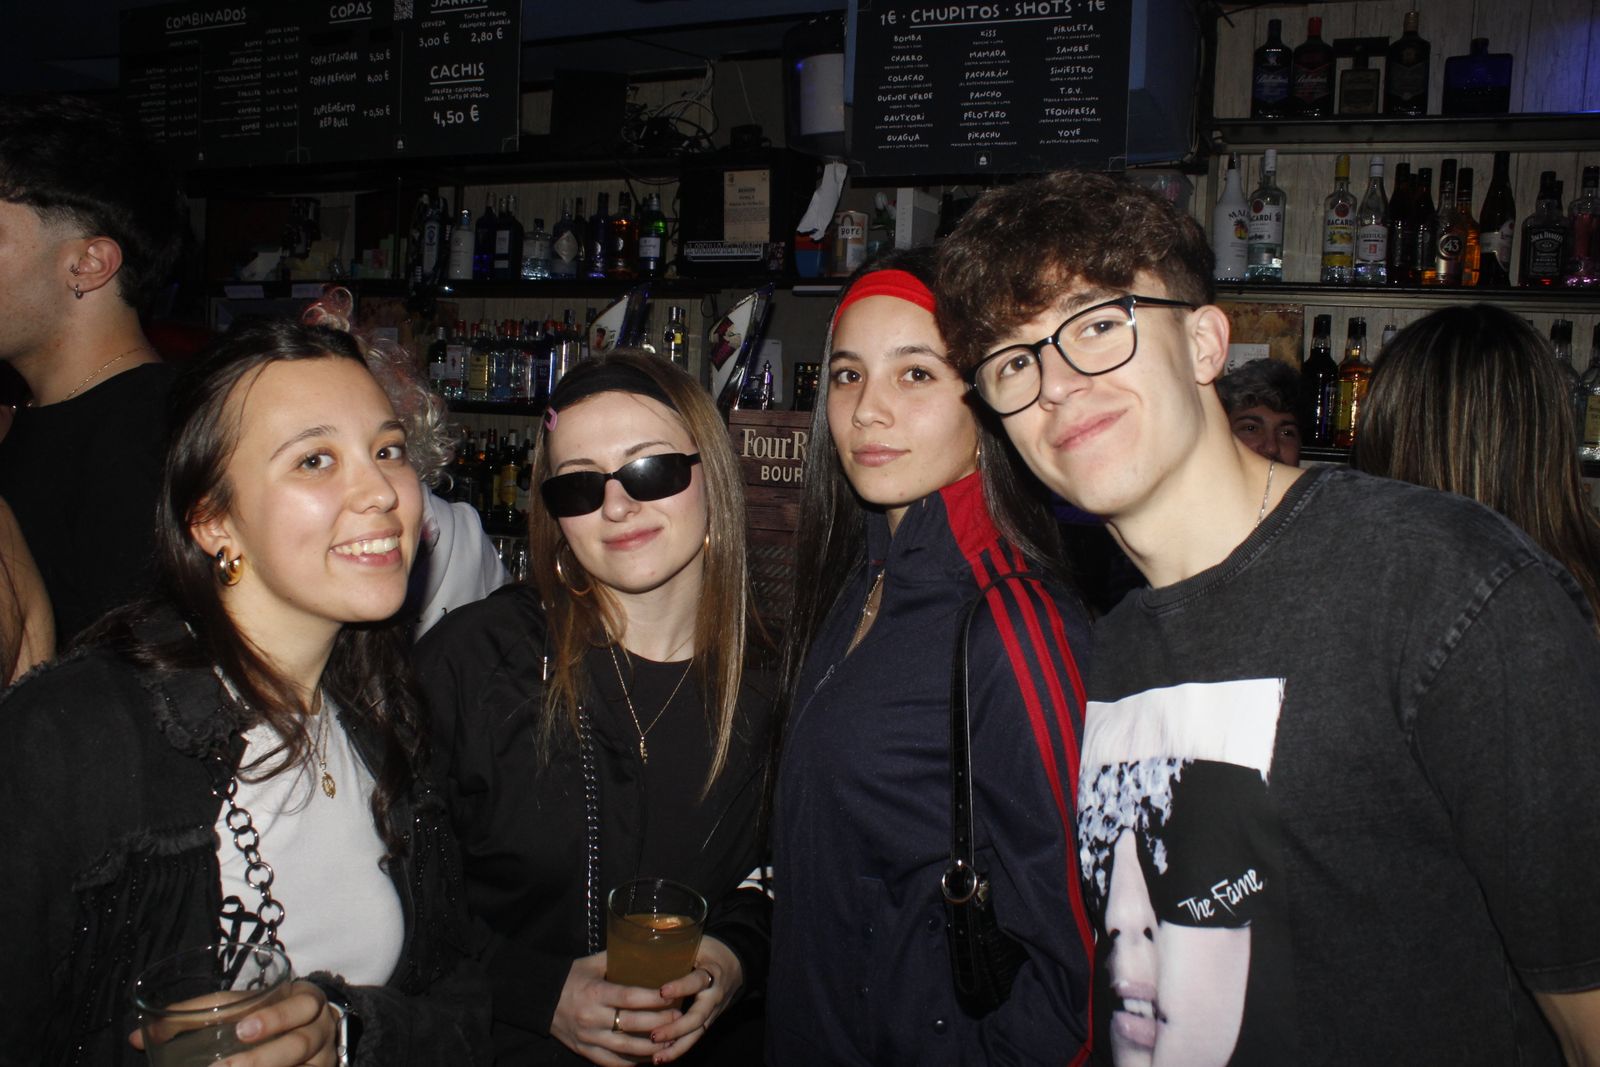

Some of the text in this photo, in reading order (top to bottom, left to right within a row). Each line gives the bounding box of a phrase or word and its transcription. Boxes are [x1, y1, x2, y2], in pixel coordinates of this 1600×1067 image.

[329, 2, 372, 19] COPAS
[880, 0, 1106, 26] 1€ CHUPITOS SHOTS 1€
[165, 8, 247, 30] COMBINADOS
[418, 37, 440, 48] 3,00
[471, 32, 493, 44] 2,80
[894, 34, 922, 43] BOMBA
[969, 49, 1006, 59] MAMADA
[1056, 44, 1089, 55] SANGRE
[310, 55, 327, 66] COPA
[430, 62, 485, 79] CACHIS
[965, 68, 1009, 80] PACHARÁN
[310, 75, 327, 86] COPA
[887, 74, 924, 83] COLACAO
[877, 92, 933, 102] DUENDE VERDE
[969, 91, 1002, 100] PANCHO
[313, 102, 356, 116] SUPLEMENTO
[433, 109, 464, 127] 4,50
[963, 110, 1007, 121] PELOTAZO
[334, 116, 349, 128] BULL
[886, 133, 920, 142] GUAGUA
[1058, 128, 1081, 137] YOYE
[1443, 238, 1461, 252] 43
[741, 428, 791, 460] Four
[1177, 869, 1263, 922] The Fame
